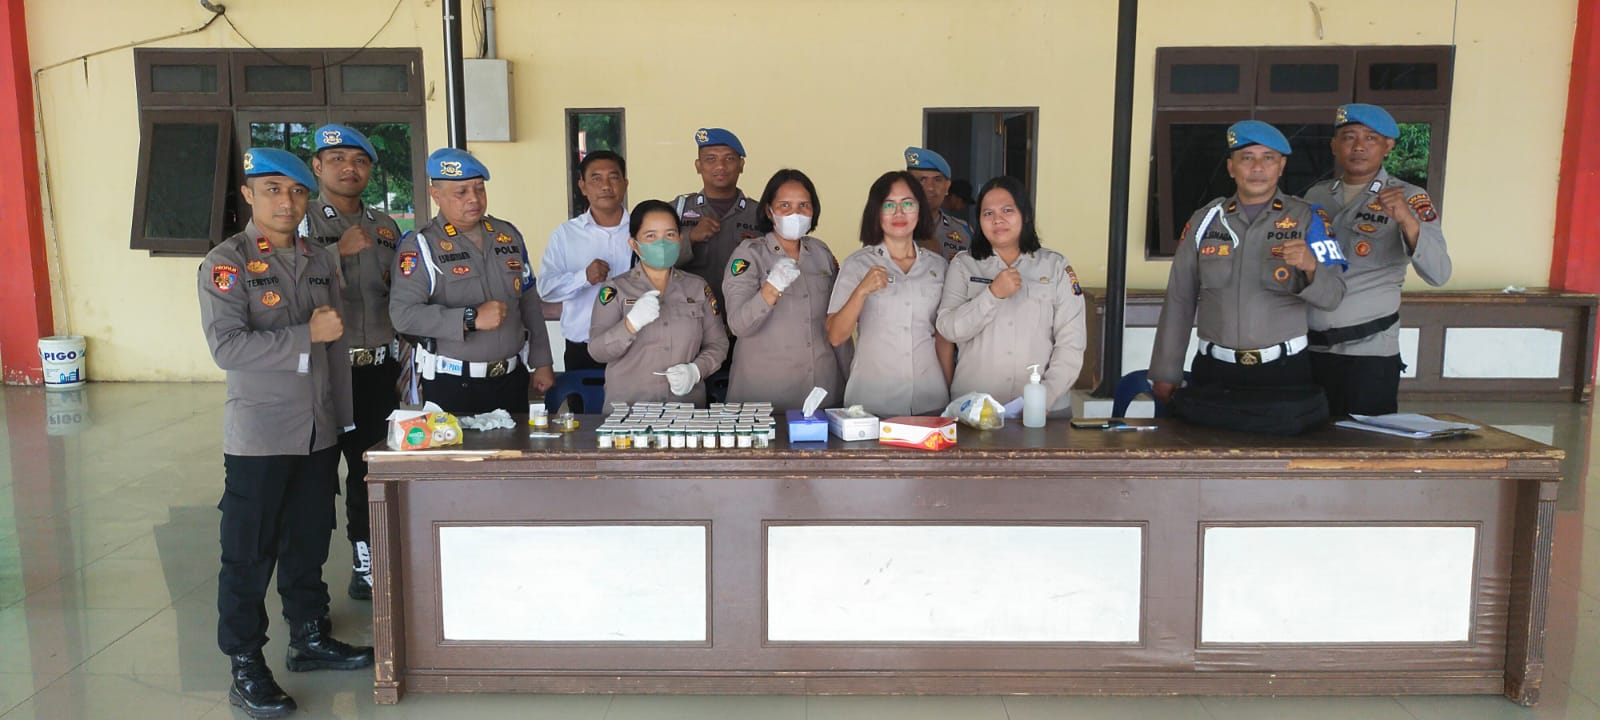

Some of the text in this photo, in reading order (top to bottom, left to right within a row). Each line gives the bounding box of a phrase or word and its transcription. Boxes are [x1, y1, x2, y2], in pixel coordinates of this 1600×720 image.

[1355, 212, 1388, 224] POLRI
[1267, 231, 1302, 241] POLRI
[494, 245, 521, 256] POLRI
[43, 350, 77, 361] PIGO
